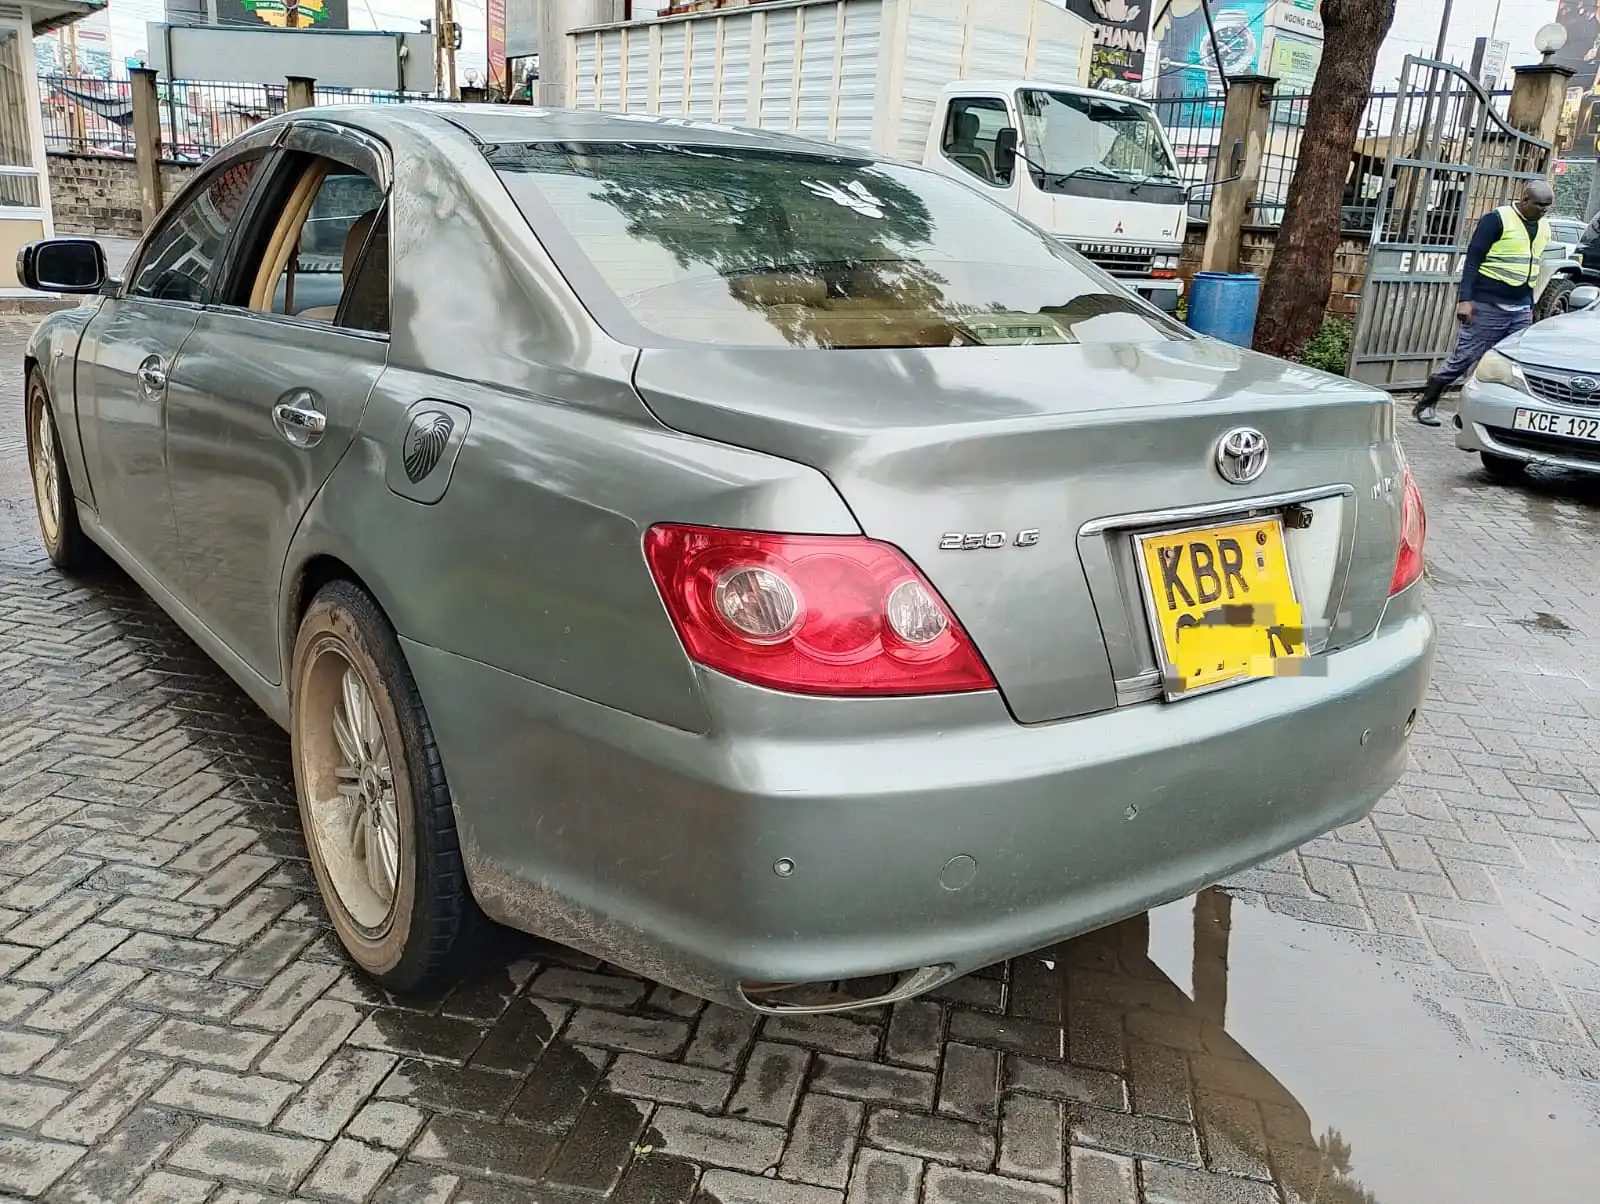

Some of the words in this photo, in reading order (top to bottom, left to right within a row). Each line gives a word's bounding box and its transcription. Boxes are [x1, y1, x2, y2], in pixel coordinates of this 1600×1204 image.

[1080, 244, 1153, 255] MITSUBISHI
[1527, 412, 1560, 433] KCE
[1565, 418, 1599, 438] 192
[939, 532, 1007, 550] 250
[1013, 528, 1040, 547] G
[1157, 538, 1249, 610] KBR
